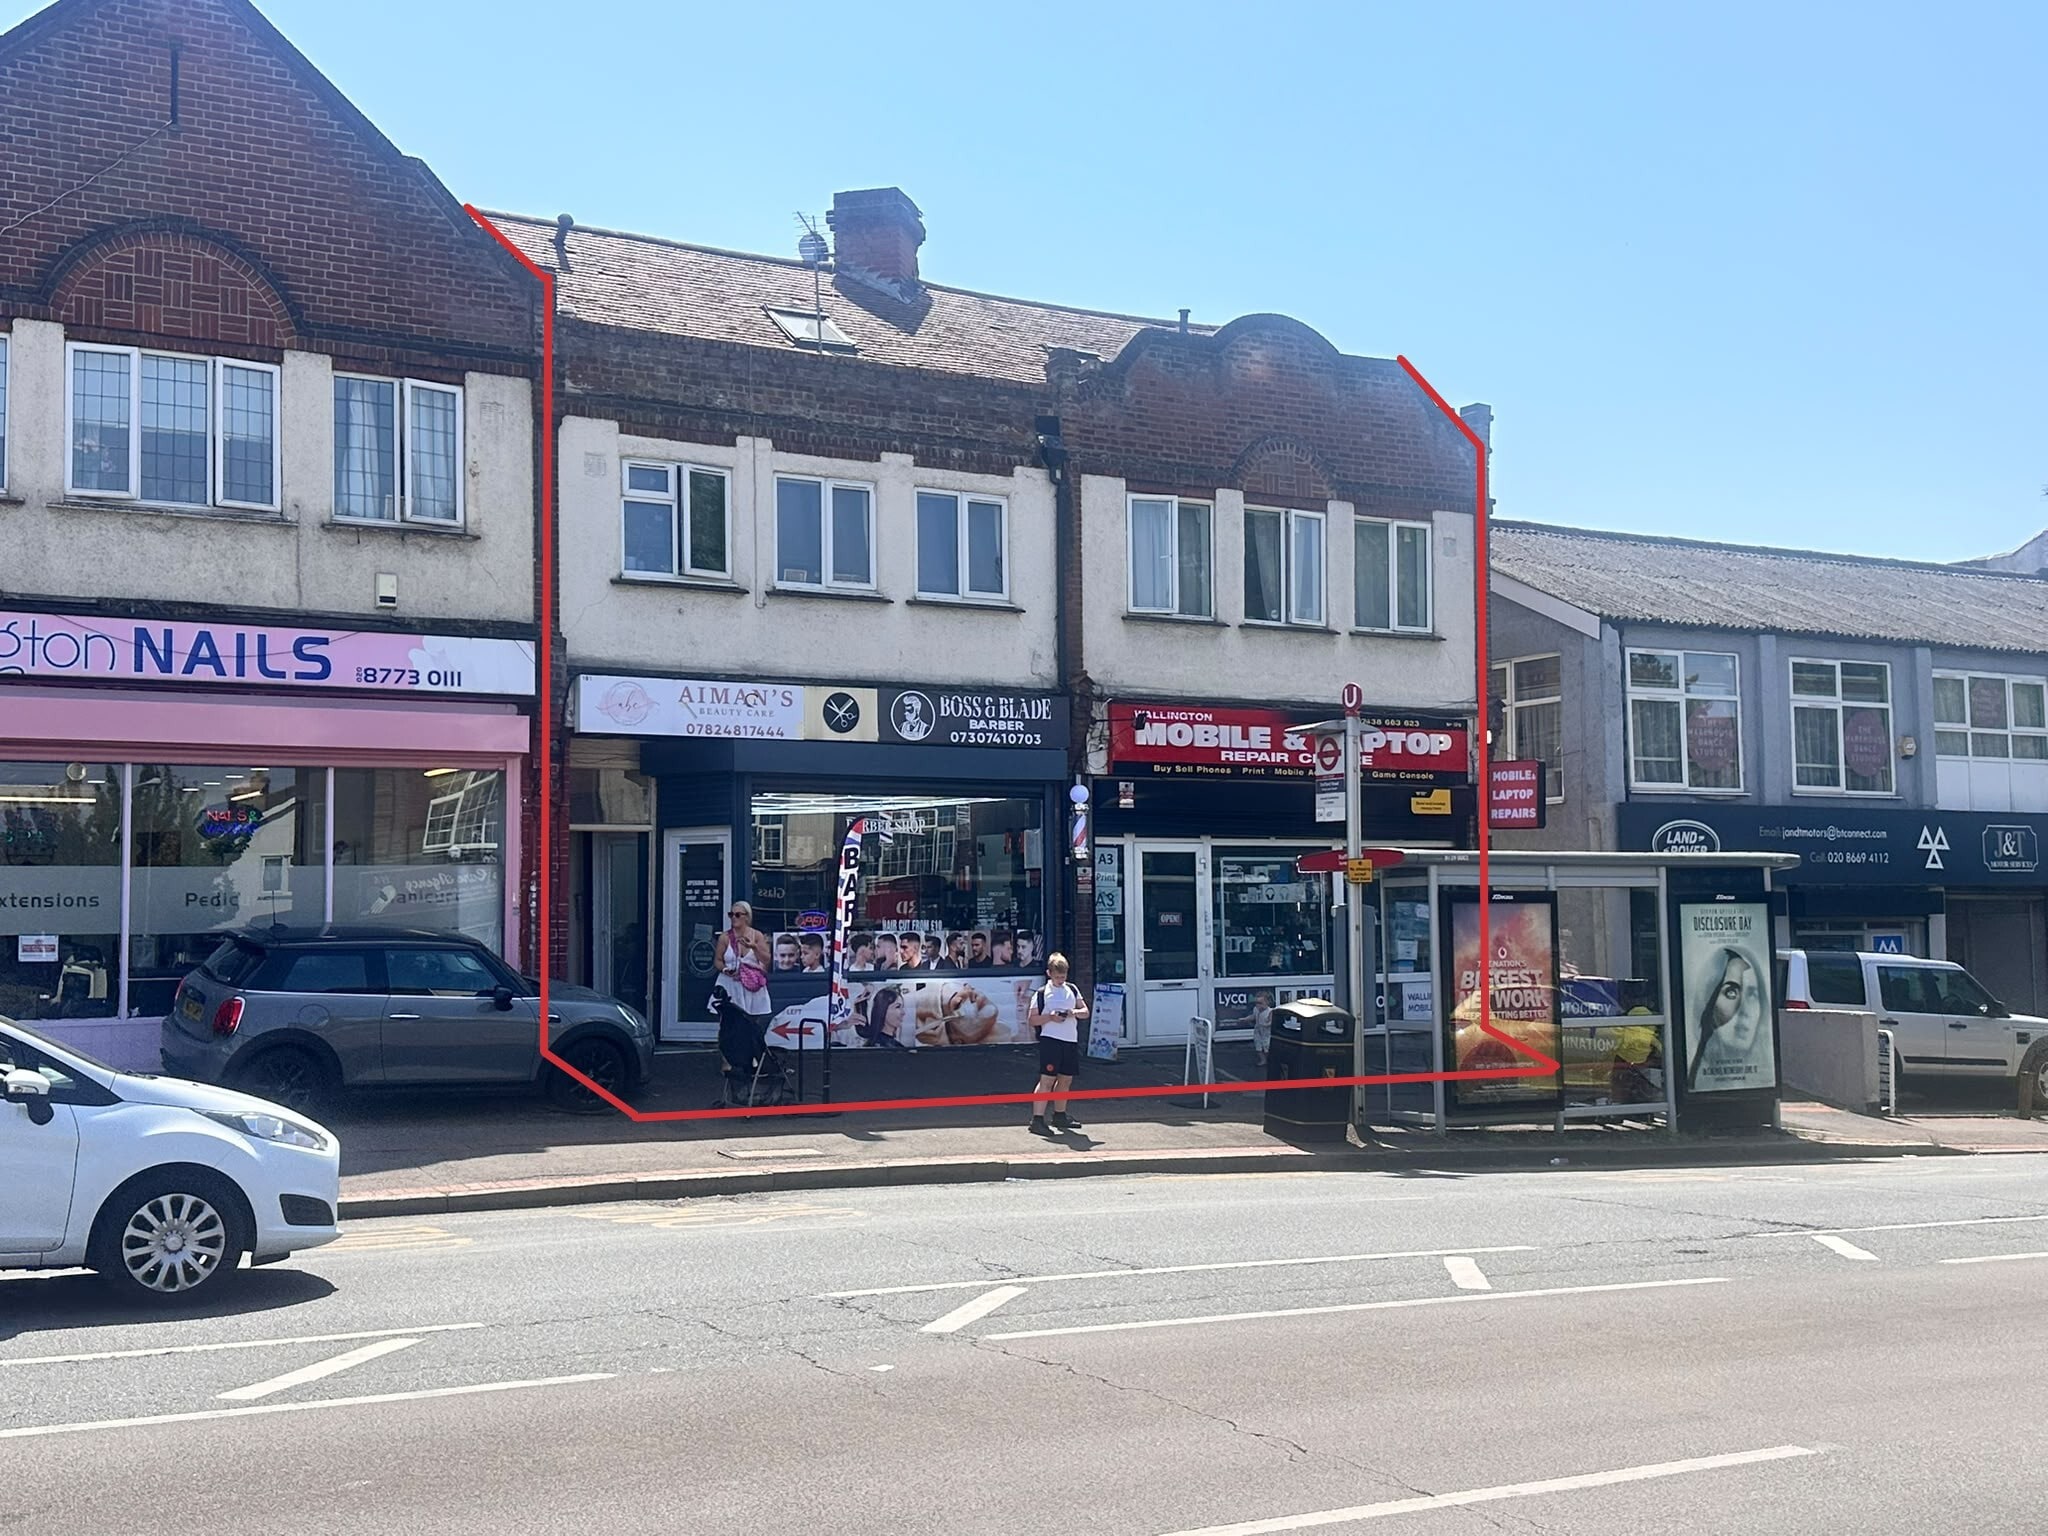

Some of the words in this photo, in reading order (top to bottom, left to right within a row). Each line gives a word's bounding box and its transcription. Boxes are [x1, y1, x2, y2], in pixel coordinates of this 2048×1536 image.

[133, 626, 332, 681] NAILS
[364, 667, 420, 685] 8773
[427, 670, 462, 687] 0111
[679, 686, 793, 707] AIMAN'S
[699, 707, 741, 716] BEAUTY
[747, 709, 775, 717] CARE
[940, 695, 982, 718] BOSS
[985, 696, 995, 718] &
[999, 697, 1052, 720] BLADE
[1134, 710, 1213, 721] WALLINGTON
[686, 723, 785, 737] 07824817444
[969, 719, 1024, 731] BARBER
[950, 732, 1042, 745] 07307410703
[1134, 722, 1272, 749] MOBILE
[1283, 733, 1308, 750] &
[1360, 731, 1452, 756] PTOP
[1221, 751, 1289, 763] REPAIR
[1153, 765, 1172, 774] Buy
[1175, 765, 1193, 773] Sell
[1196, 766, 1232, 774] Phones
[1242, 767, 1265, 775] Print
[1274, 768, 1305, 776] Mobile
[1372, 771, 1396, 779] Game
[1399, 772, 1435, 780] Console
[1493, 770, 1531, 781] MOBILE
[1493, 789, 1533, 800] LAPTOP
[1491, 808, 1536, 819] REPAIRS
[1667, 831, 1698, 844] LAND
[1994, 831, 2026, 857] J&T
[1098, 854, 1114, 864] A3
[1827, 852, 1844, 863] 020
[1846, 853, 1866, 863] 8669
[1869, 853, 1889, 863] 4112
[1096, 873, 1116, 882] Print
[0, 893, 99, 907] xtensions
[1693, 916, 1737, 931] DISCLOSURE
[1738, 916, 1752, 930] DAY
[1218, 991, 1247, 1007] Lyca
